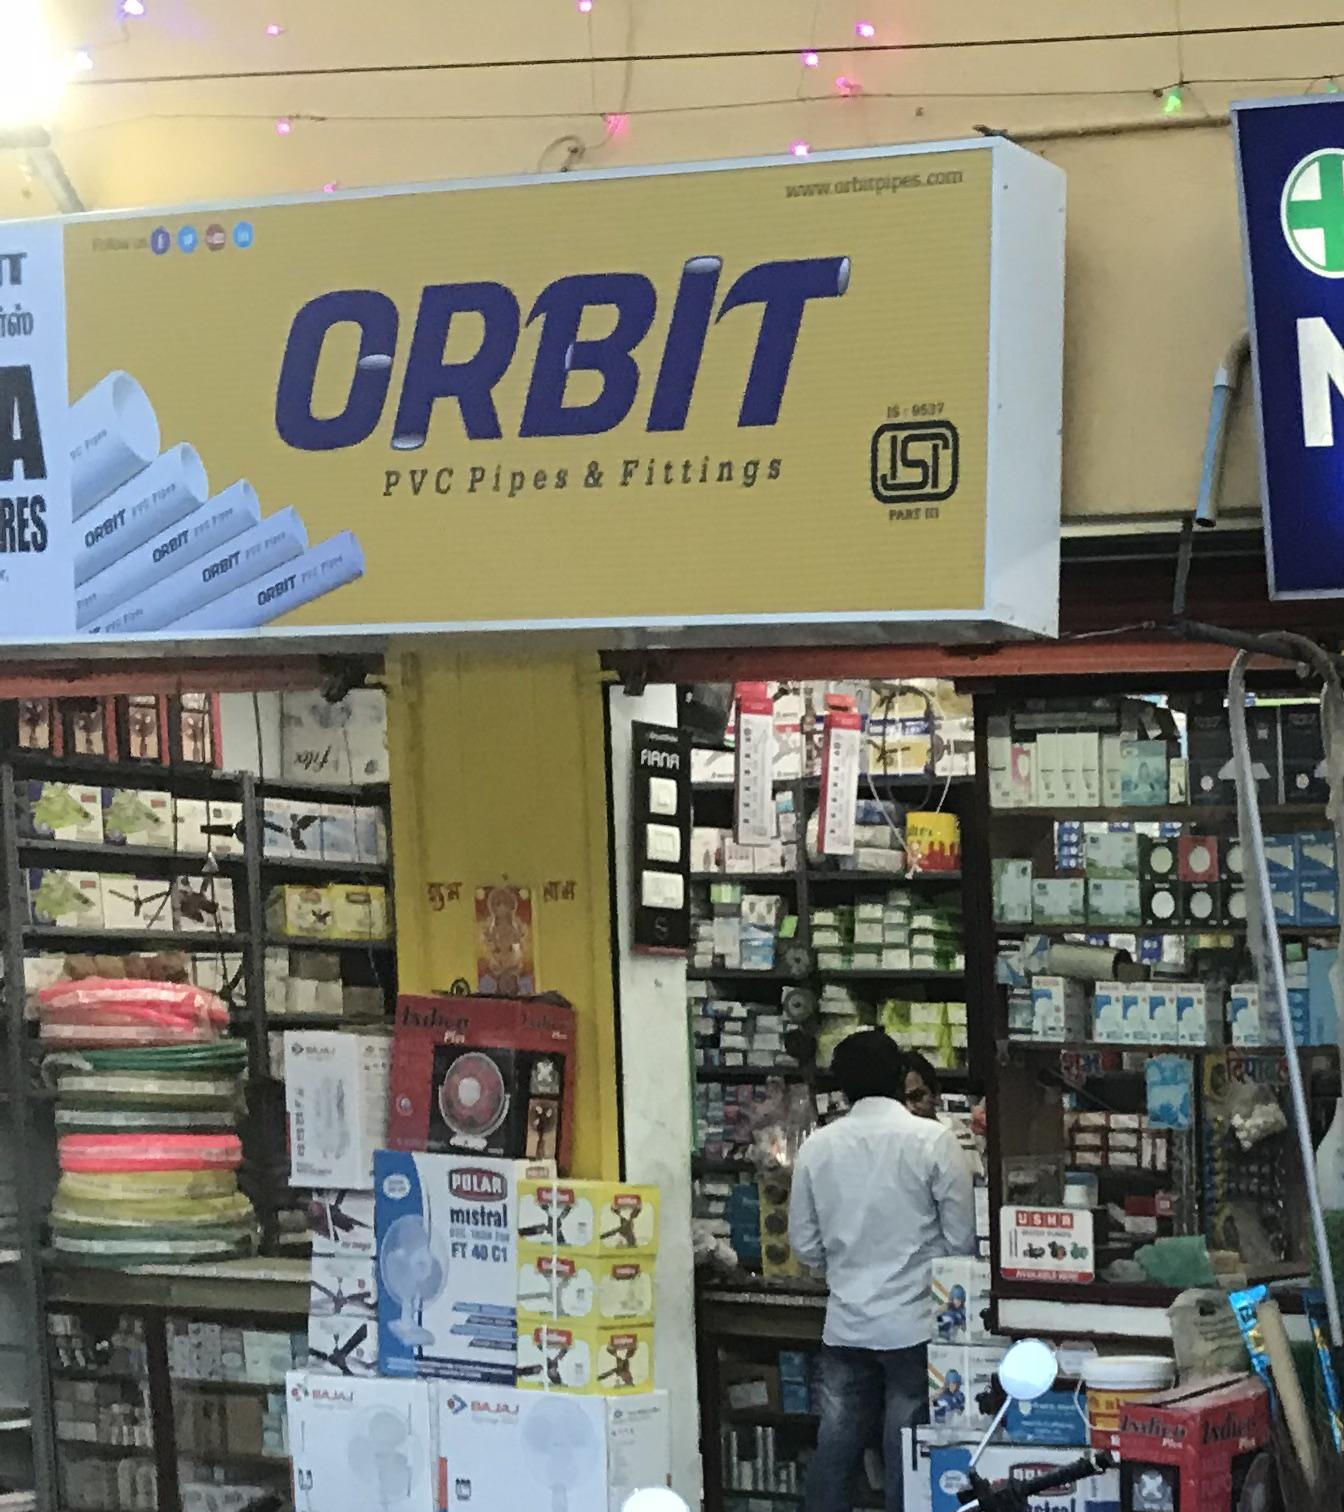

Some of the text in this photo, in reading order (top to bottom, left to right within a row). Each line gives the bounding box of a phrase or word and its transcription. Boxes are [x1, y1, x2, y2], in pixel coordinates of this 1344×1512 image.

[274, 255, 852, 452] ORBIT
[383, 455, 782, 498] PVC Pipes & Fittings
[84, 508, 127, 549] ORBIT
[152, 530, 190, 564] ORBIT
[202, 551, 241, 584] ORBIT
[257, 574, 297, 606] ORBIT
[450, 1204, 508, 1227] mistral
[1017, 1211, 1073, 1228] USHA
[451, 1243, 469, 1260] FT
[312, 1388, 354, 1402] BAJAJ
[471, 1400, 521, 1415] BAJAJ
